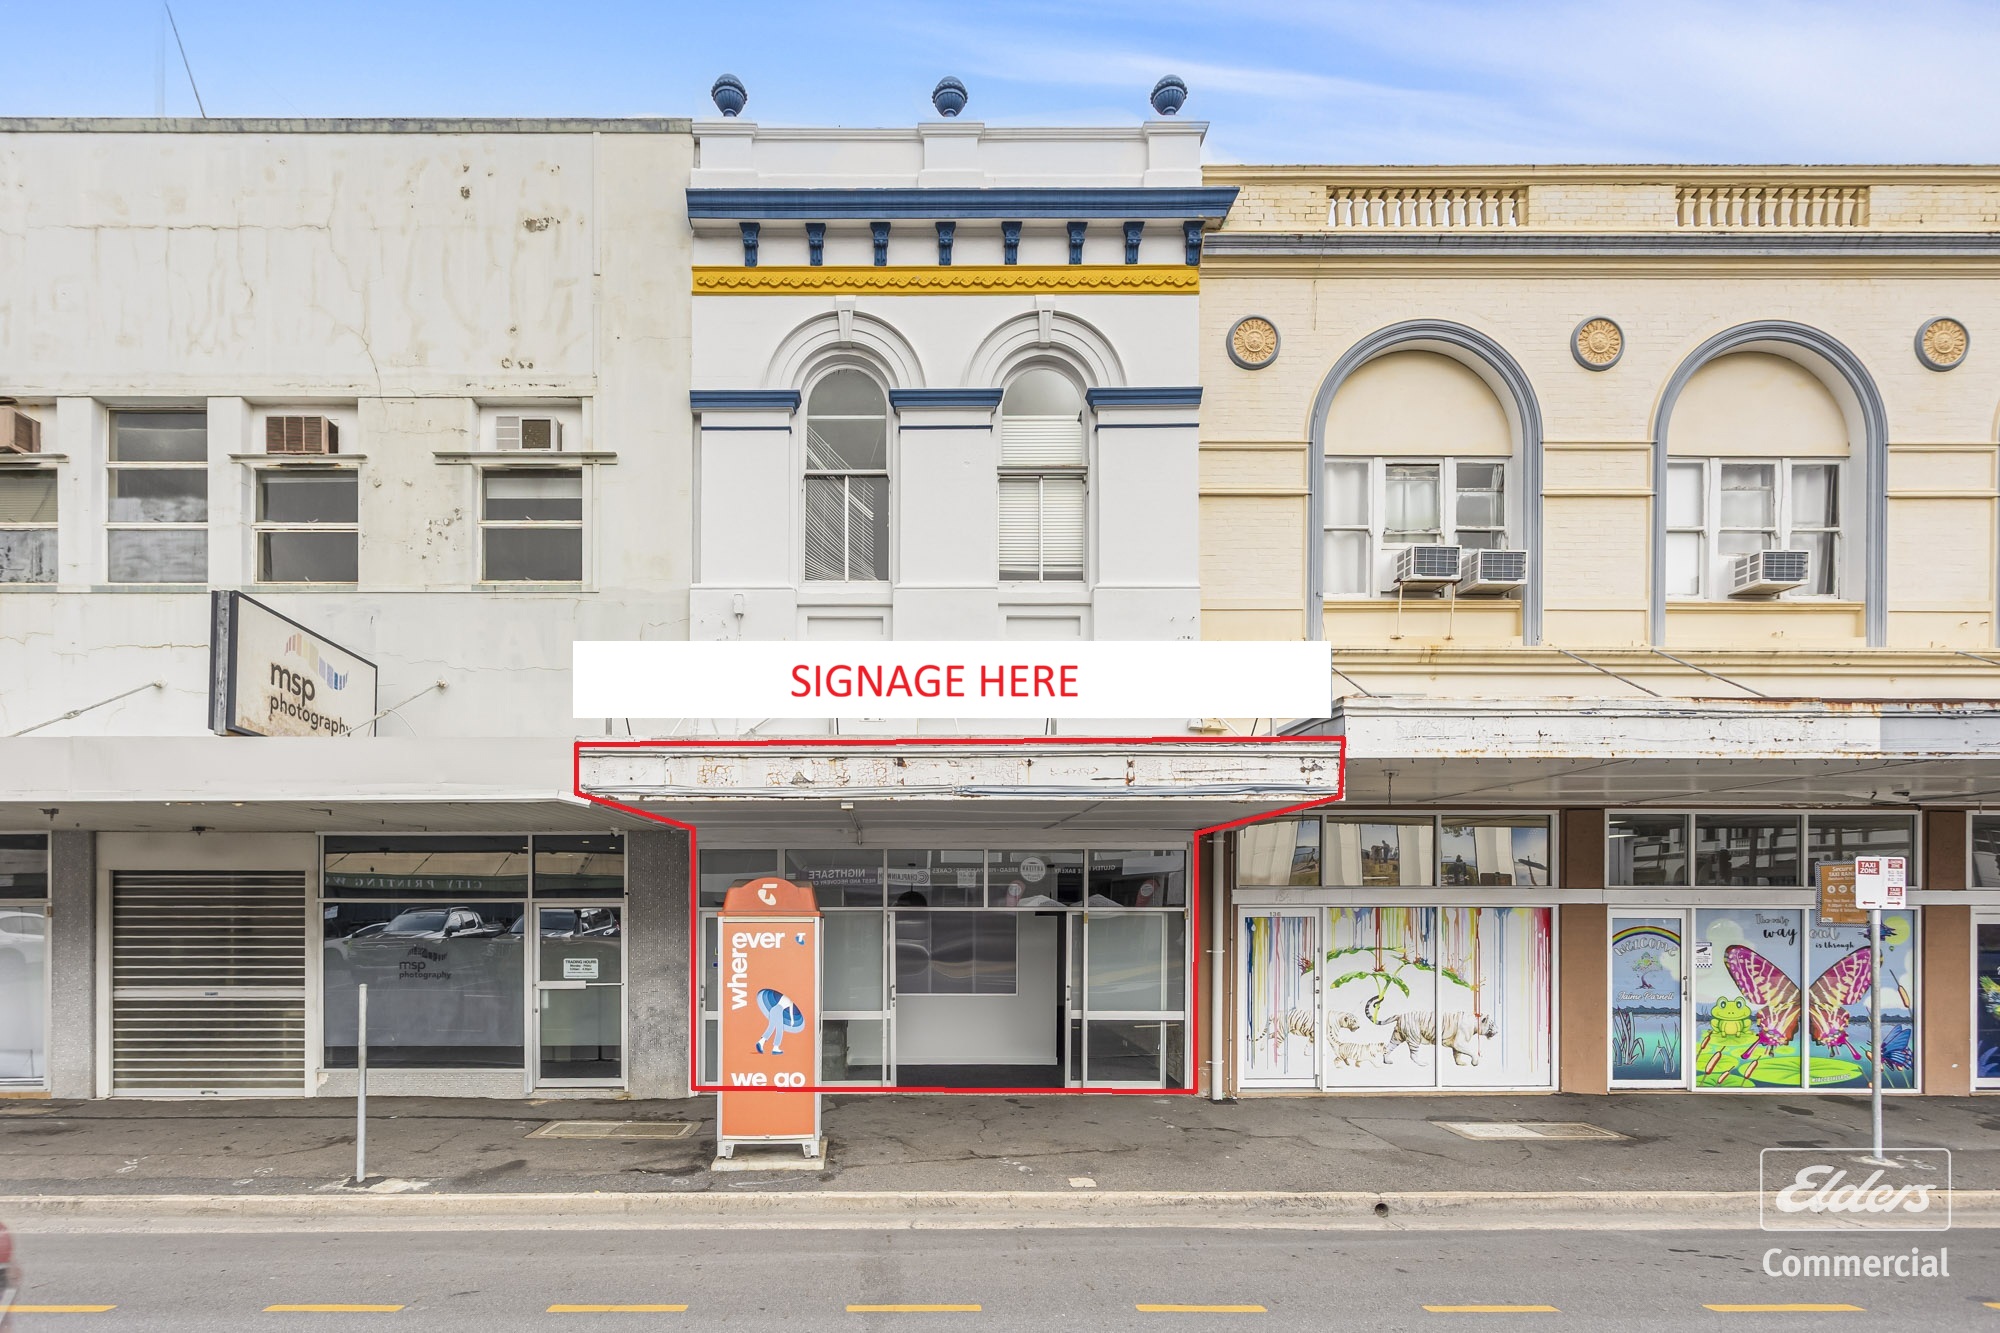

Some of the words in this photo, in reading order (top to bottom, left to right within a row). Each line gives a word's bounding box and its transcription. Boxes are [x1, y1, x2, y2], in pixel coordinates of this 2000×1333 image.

[271, 662, 316, 707] msp
[270, 693, 352, 737] photography
[1763, 928, 1798, 946] way
[1824, 941, 1854, 951] through
[400, 962, 426, 972] msp
[400, 970, 452, 980] photography
[731, 1072, 768, 1086] we
